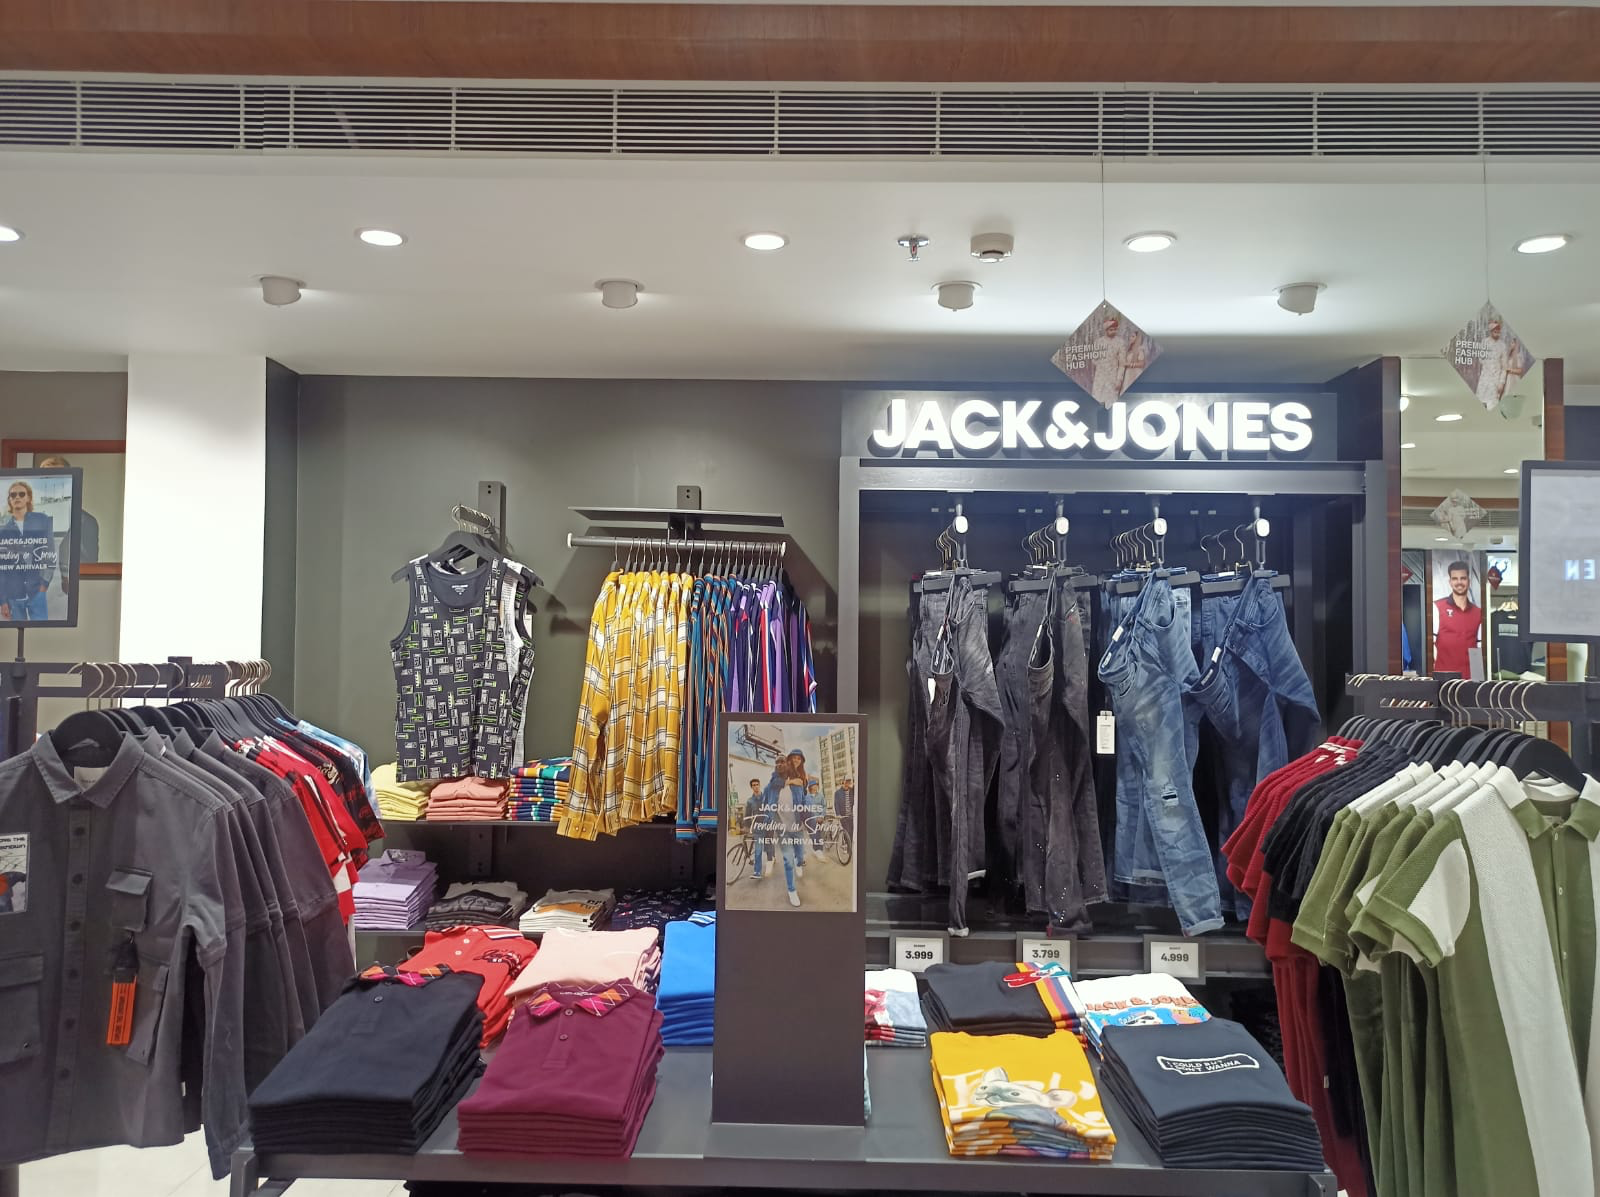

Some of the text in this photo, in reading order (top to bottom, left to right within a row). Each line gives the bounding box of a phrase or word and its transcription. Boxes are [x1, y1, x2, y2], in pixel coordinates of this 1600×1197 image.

[1066, 360, 1086, 370] HUB
[1455, 356, 1473, 365] HUB
[872, 398, 1314, 452] JACK&JONES
[758, 803, 824, 813] JACK&JONES
[743, 814, 787, 838] Trending
[790, 821, 800, 831] in
[758, 837, 824, 846] NEW ARRIVALS
[905, 950, 934, 960] 3.999
[1032, 949, 1060, 959] 3.799
[1161, 952, 1189, 962] 4.999
[1205, 1060, 1242, 1071] WANNA
